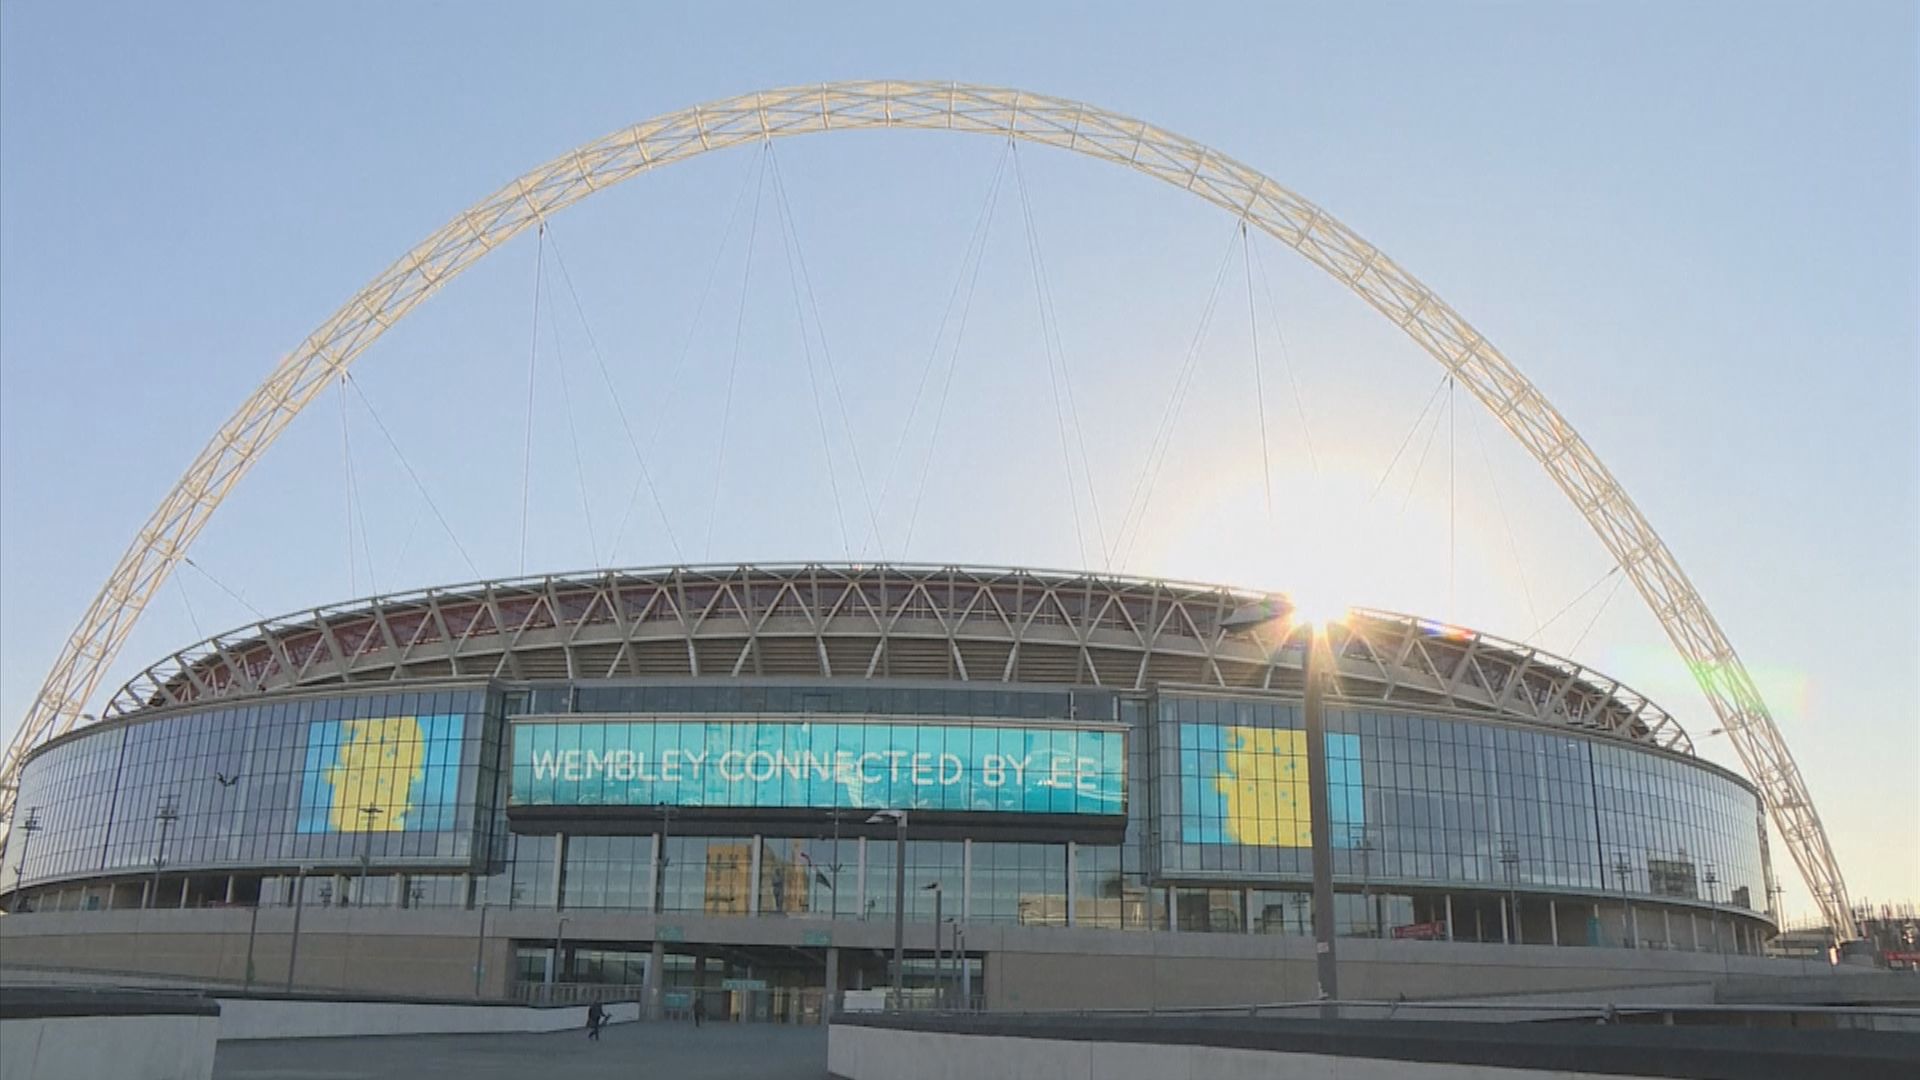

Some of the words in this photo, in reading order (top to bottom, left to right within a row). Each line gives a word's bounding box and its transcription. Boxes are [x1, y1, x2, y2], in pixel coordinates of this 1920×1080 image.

[531, 749, 707, 781] WEMBLEY
[718, 749, 963, 786] CONNECTED
[981, 754, 1032, 788] BY
[1050, 756, 1098, 790] EE
